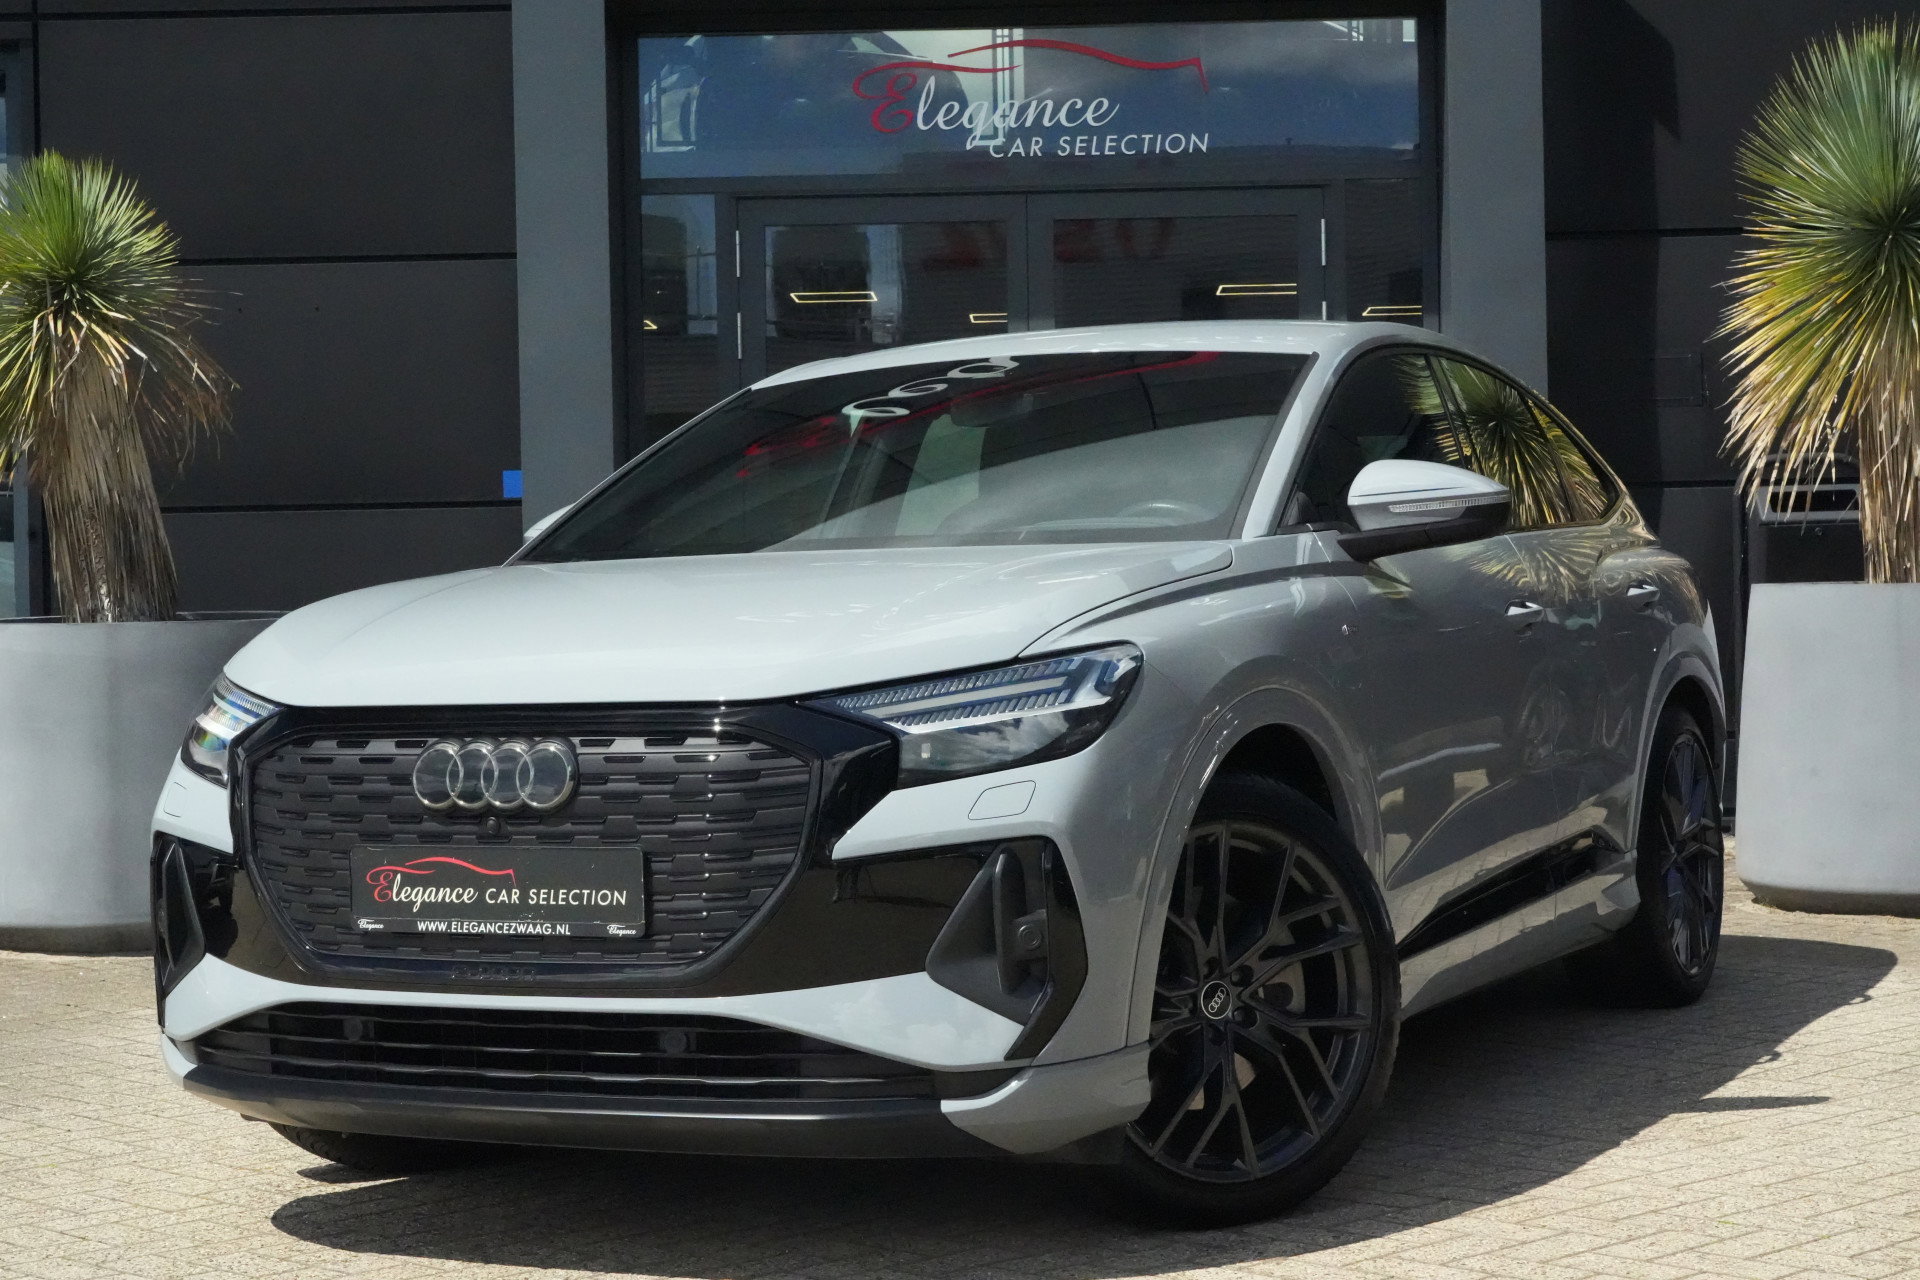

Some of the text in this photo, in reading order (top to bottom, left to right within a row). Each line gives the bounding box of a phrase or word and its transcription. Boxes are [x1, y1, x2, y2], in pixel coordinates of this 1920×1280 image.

[852, 60, 1120, 151] Elegance
[990, 132, 1210, 158] CAR SELECTION
[366, 865, 627, 913] Elegance CAR SELECTION
[417, 920, 571, 936] WWW.ELEGANCEZWAAG.NL
